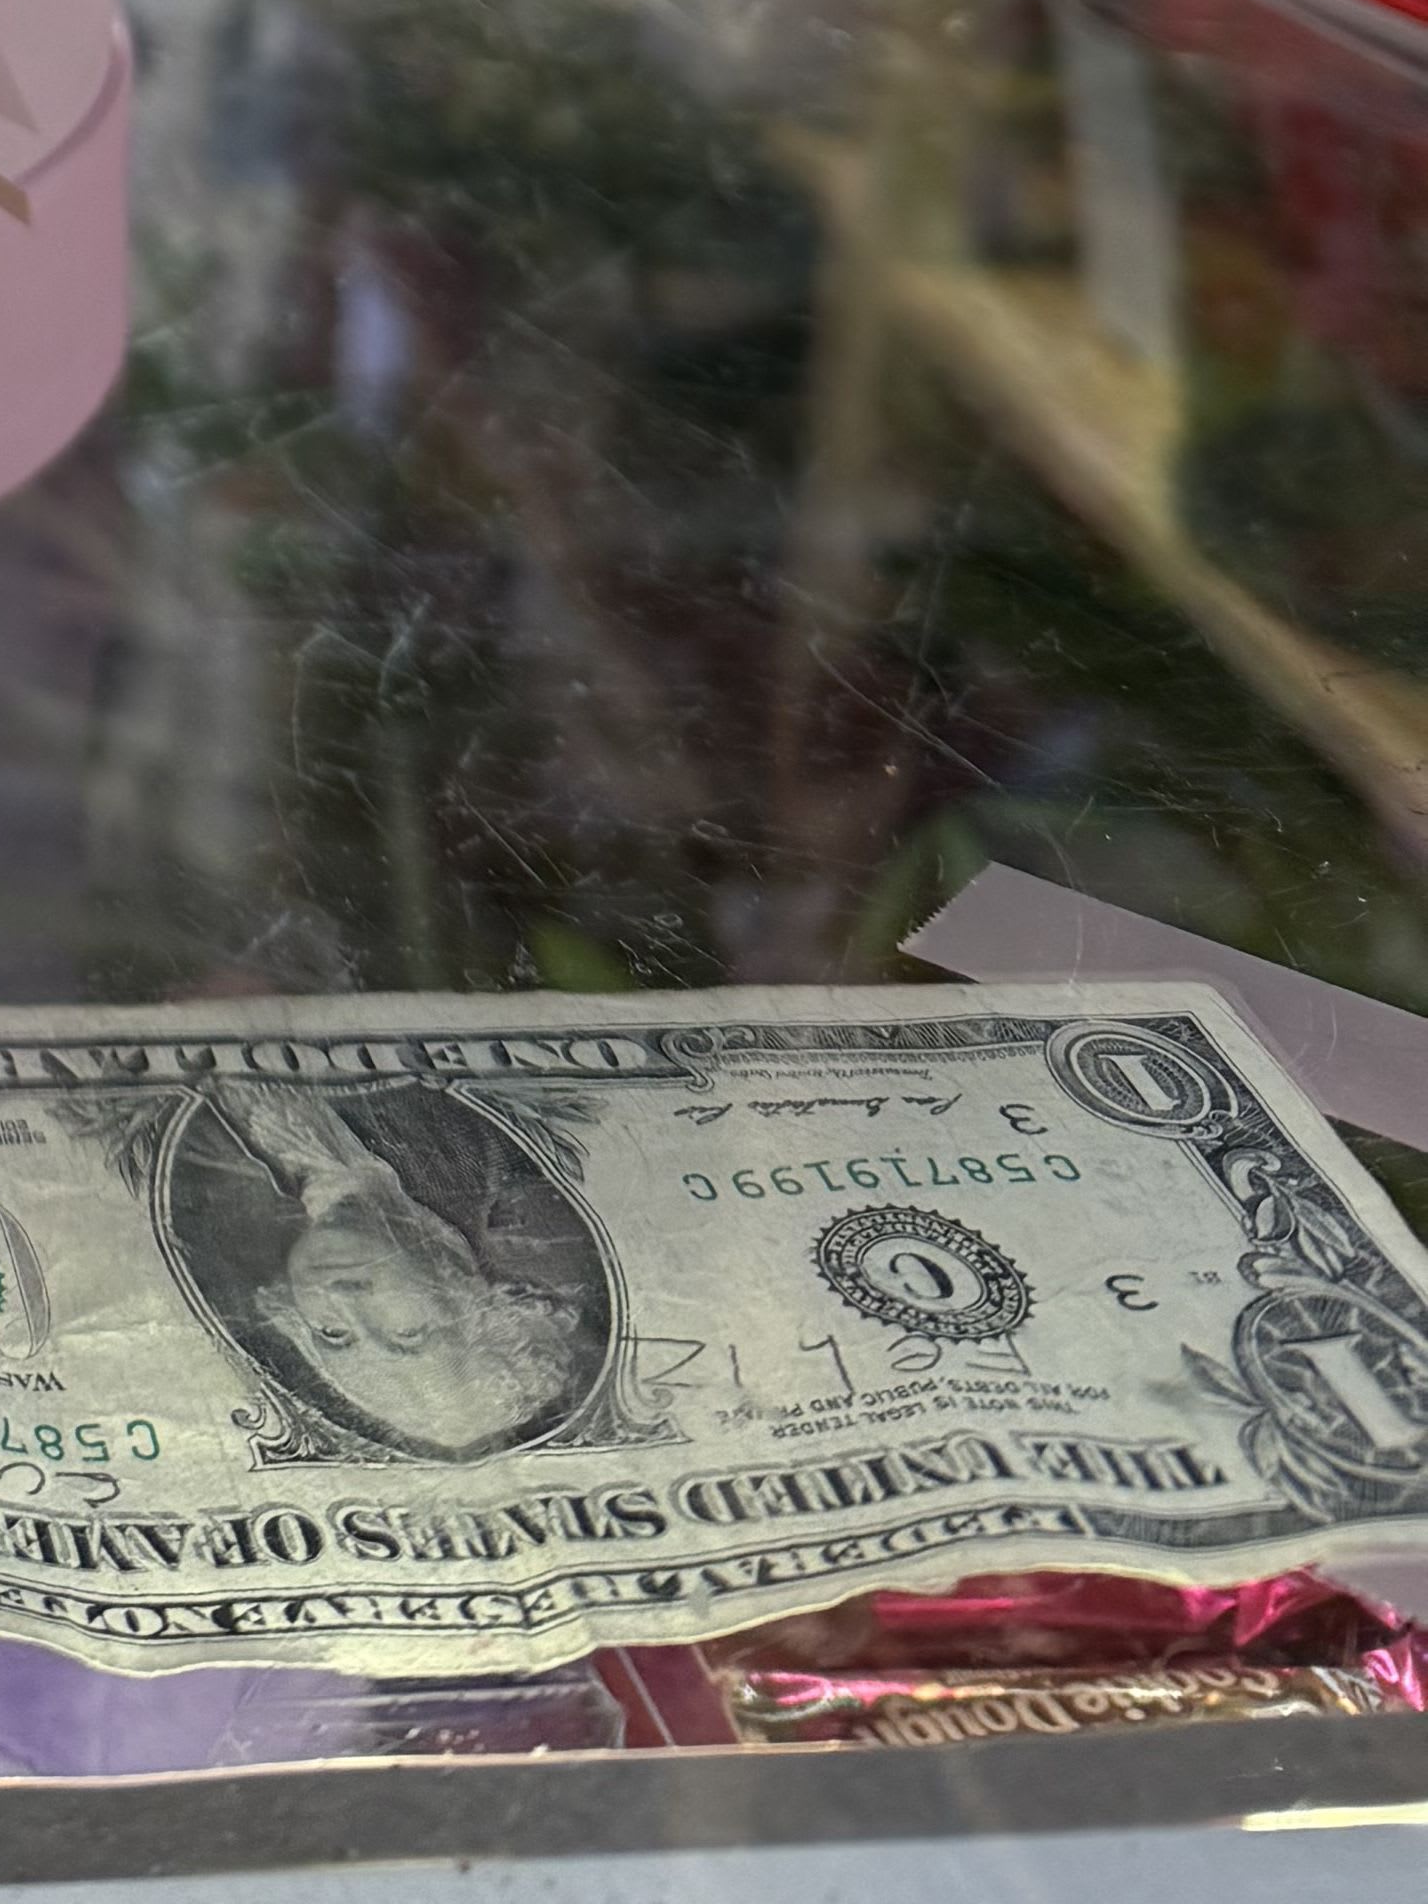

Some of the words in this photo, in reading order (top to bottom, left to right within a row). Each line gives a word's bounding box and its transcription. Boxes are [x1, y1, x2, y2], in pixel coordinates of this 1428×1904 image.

[423, 1039, 645, 1072] ONE
[1094, 1052, 1179, 1112] 1
[998, 1103, 1049, 1136] 3
[888, 1252, 955, 1300] C
[1104, 1274, 1160, 1311] 3
[808, 1393, 855, 1412] AND
[859, 1401, 928, 1424] LEGAL
[860, 1378, 939, 1404] PUBLIC
[932, 1395, 958, 1409] IS
[1279, 1332, 1428, 1450] 1
[769, 1415, 859, 1440] TENDER
[672, 1432, 1015, 1525] UNITED
[1010, 1432, 1230, 1493] THE
[197, 1502, 327, 1570] OF
[330, 1483, 670, 1562] STATES
[698, 1507, 1085, 1597] FEDERAL
[234, 1572, 690, 1629] RESERVE
